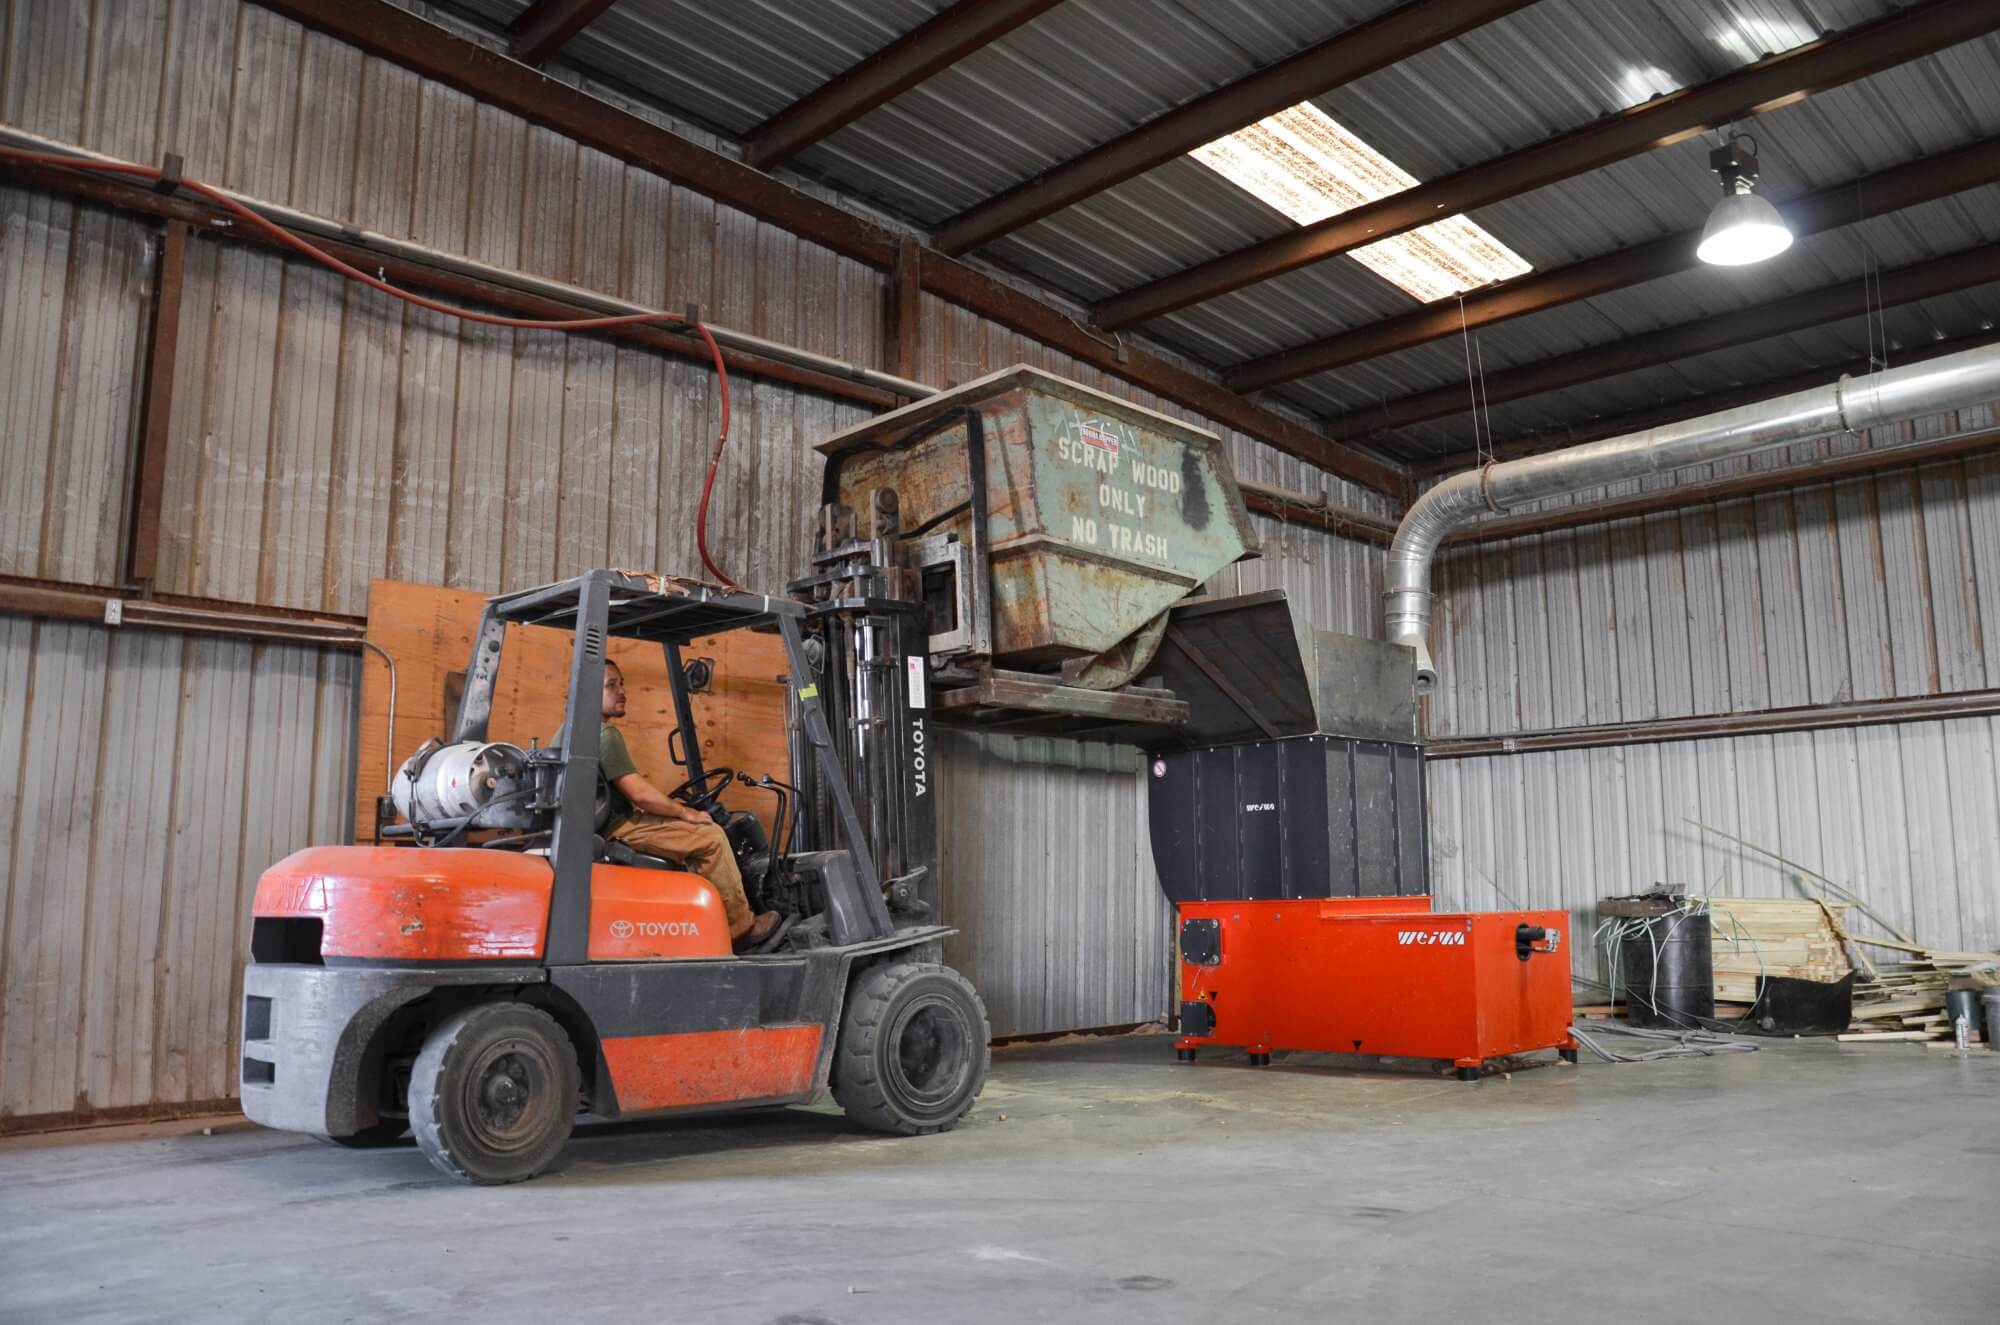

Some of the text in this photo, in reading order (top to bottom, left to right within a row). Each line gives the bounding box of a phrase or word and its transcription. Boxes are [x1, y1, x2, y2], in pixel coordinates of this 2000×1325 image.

[1058, 436, 1119, 475] SCRAP
[1132, 459, 1180, 494] WOOD
[1099, 484, 1147, 519] ONLY
[1072, 517, 1168, 560] NO TRASH
[912, 718, 926, 797] TOYOTA
[636, 922, 700, 936] TOYOTA
